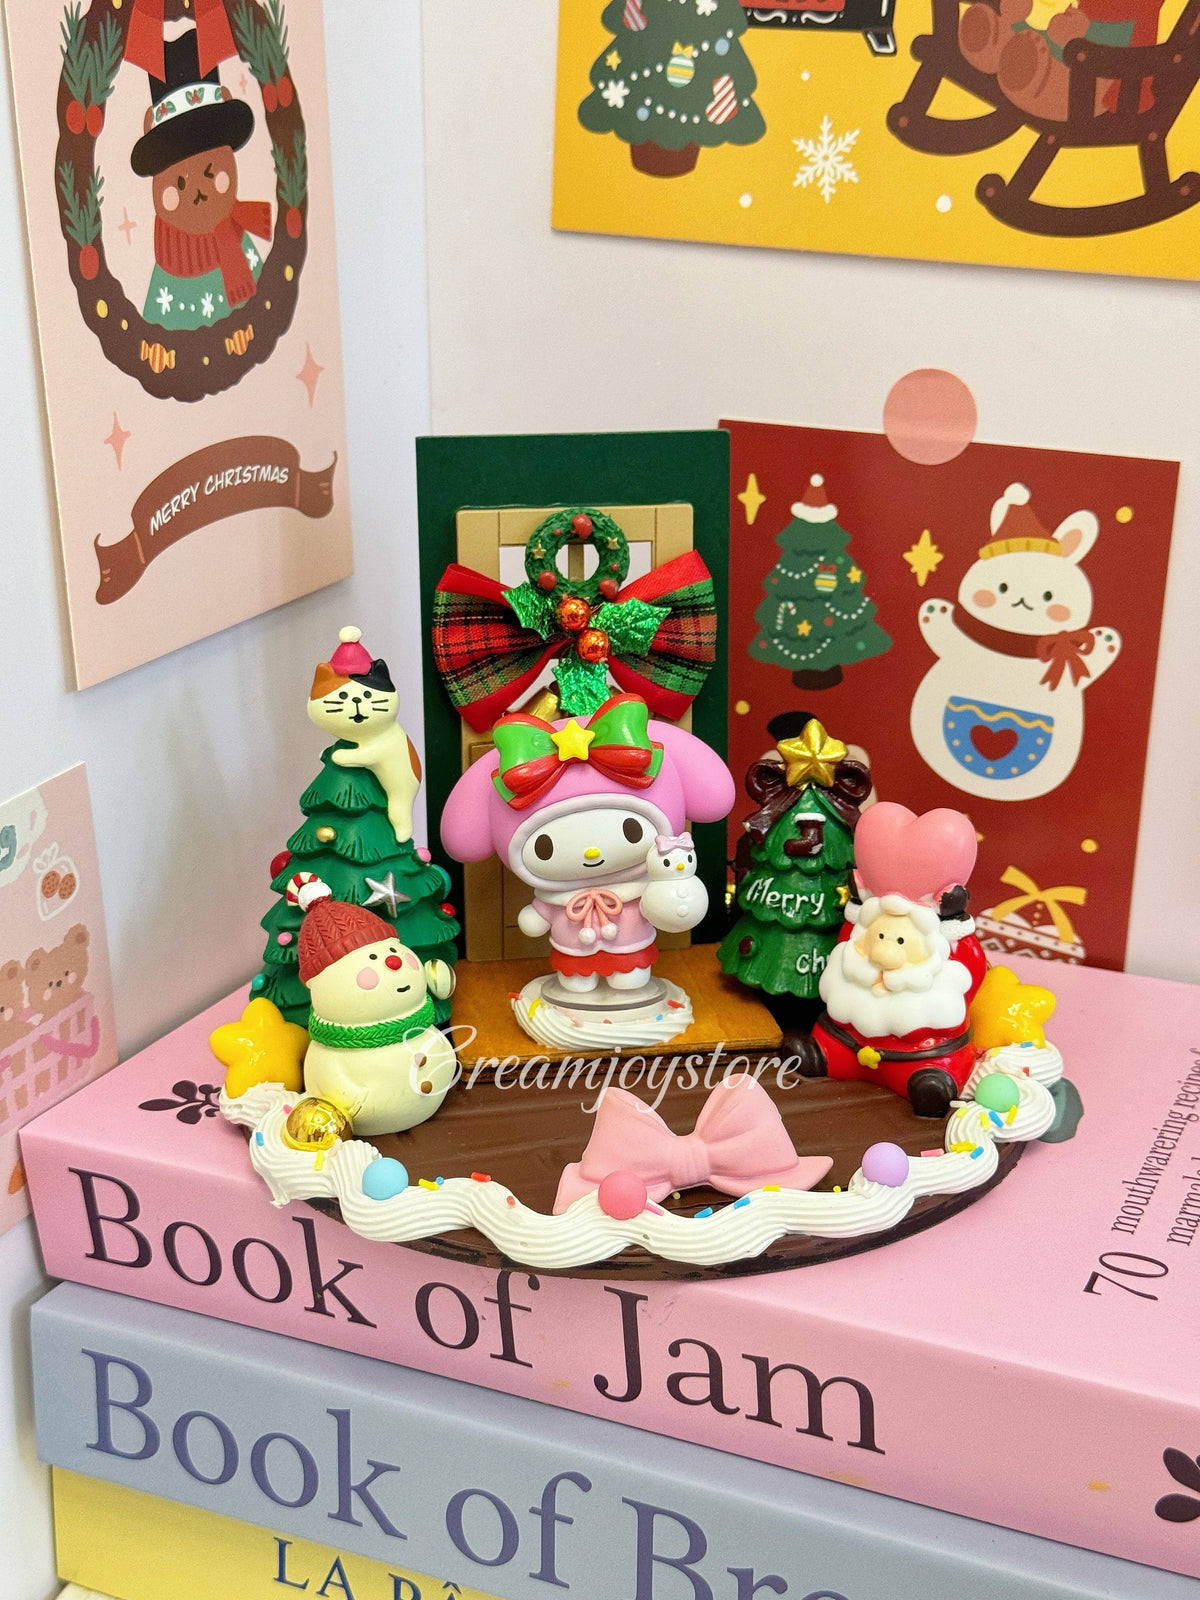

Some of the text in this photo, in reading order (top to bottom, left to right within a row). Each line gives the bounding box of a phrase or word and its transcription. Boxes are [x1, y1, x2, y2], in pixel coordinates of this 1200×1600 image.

[149, 464, 290, 537] MERRY CHRISTMAS
[745, 876, 826, 918] Merry
[1082, 1251, 1170, 1302] 70
[67, 1166, 886, 1456] Book of Jam
[81, 1347, 408, 1541] Book
[444, 1471, 593, 1590] of
[273, 1536, 356, 1600] LA
